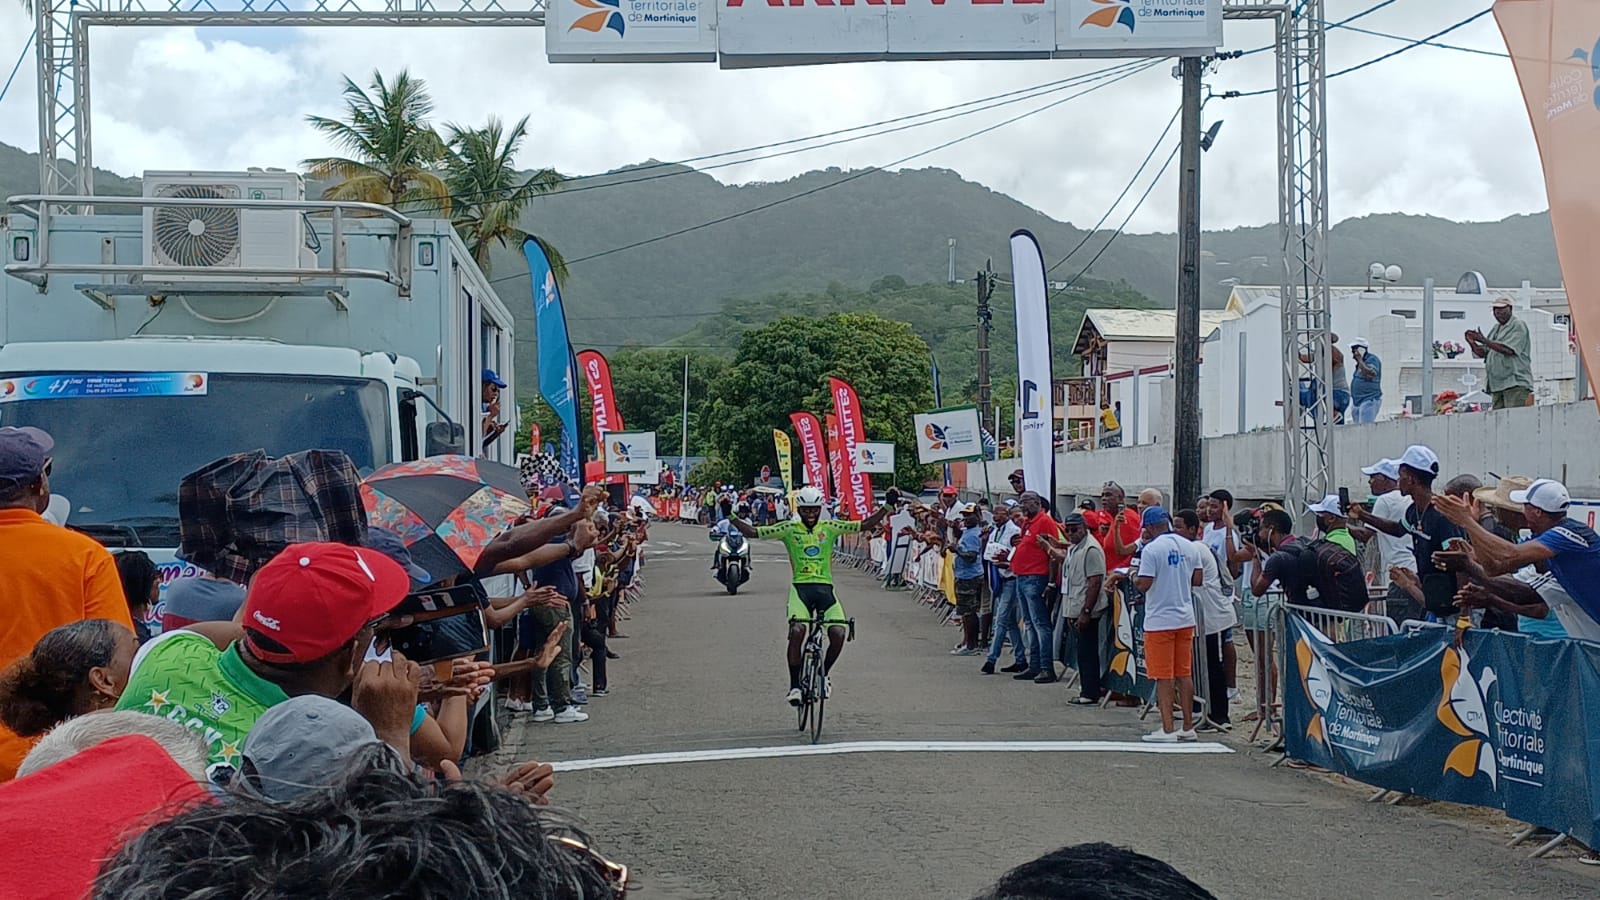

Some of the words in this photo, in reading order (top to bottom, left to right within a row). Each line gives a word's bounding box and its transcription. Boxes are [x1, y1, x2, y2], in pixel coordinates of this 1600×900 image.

[630, 0, 697, 11] Territoriale
[628, 11, 643, 22] de
[644, 13, 697, 24] Martinique
[1138, 7, 1152, 17] de
[1153, 8, 1205, 19] Martinique
[1328, 718, 1342, 736] de
